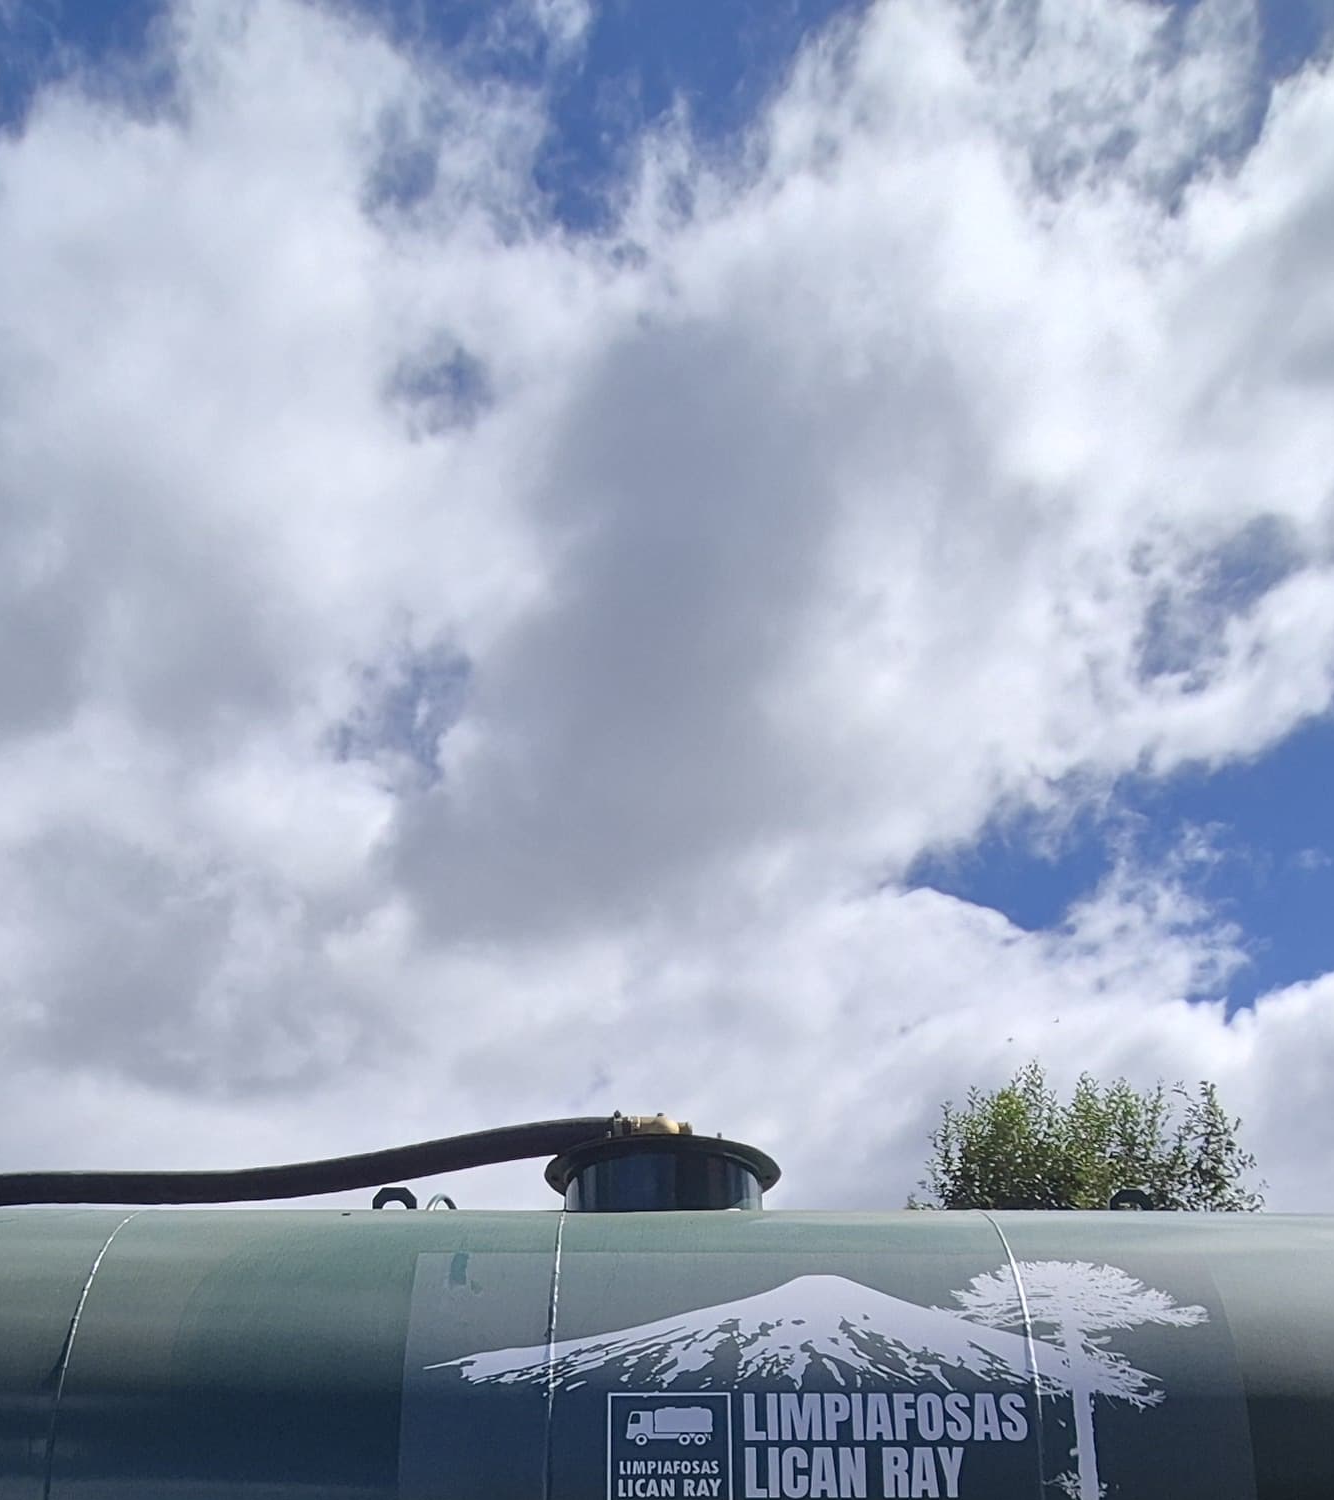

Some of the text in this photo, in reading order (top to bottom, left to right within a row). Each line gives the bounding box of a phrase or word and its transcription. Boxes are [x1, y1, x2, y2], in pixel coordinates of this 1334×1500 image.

[742, 1392, 1028, 1442] LIMPIAFOSAS
[619, 1459, 720, 1475] LIMPIAFOSAS
[744, 1446, 965, 1499] LICAN RAY
[617, 1478, 722, 1498] LICAN RAY
